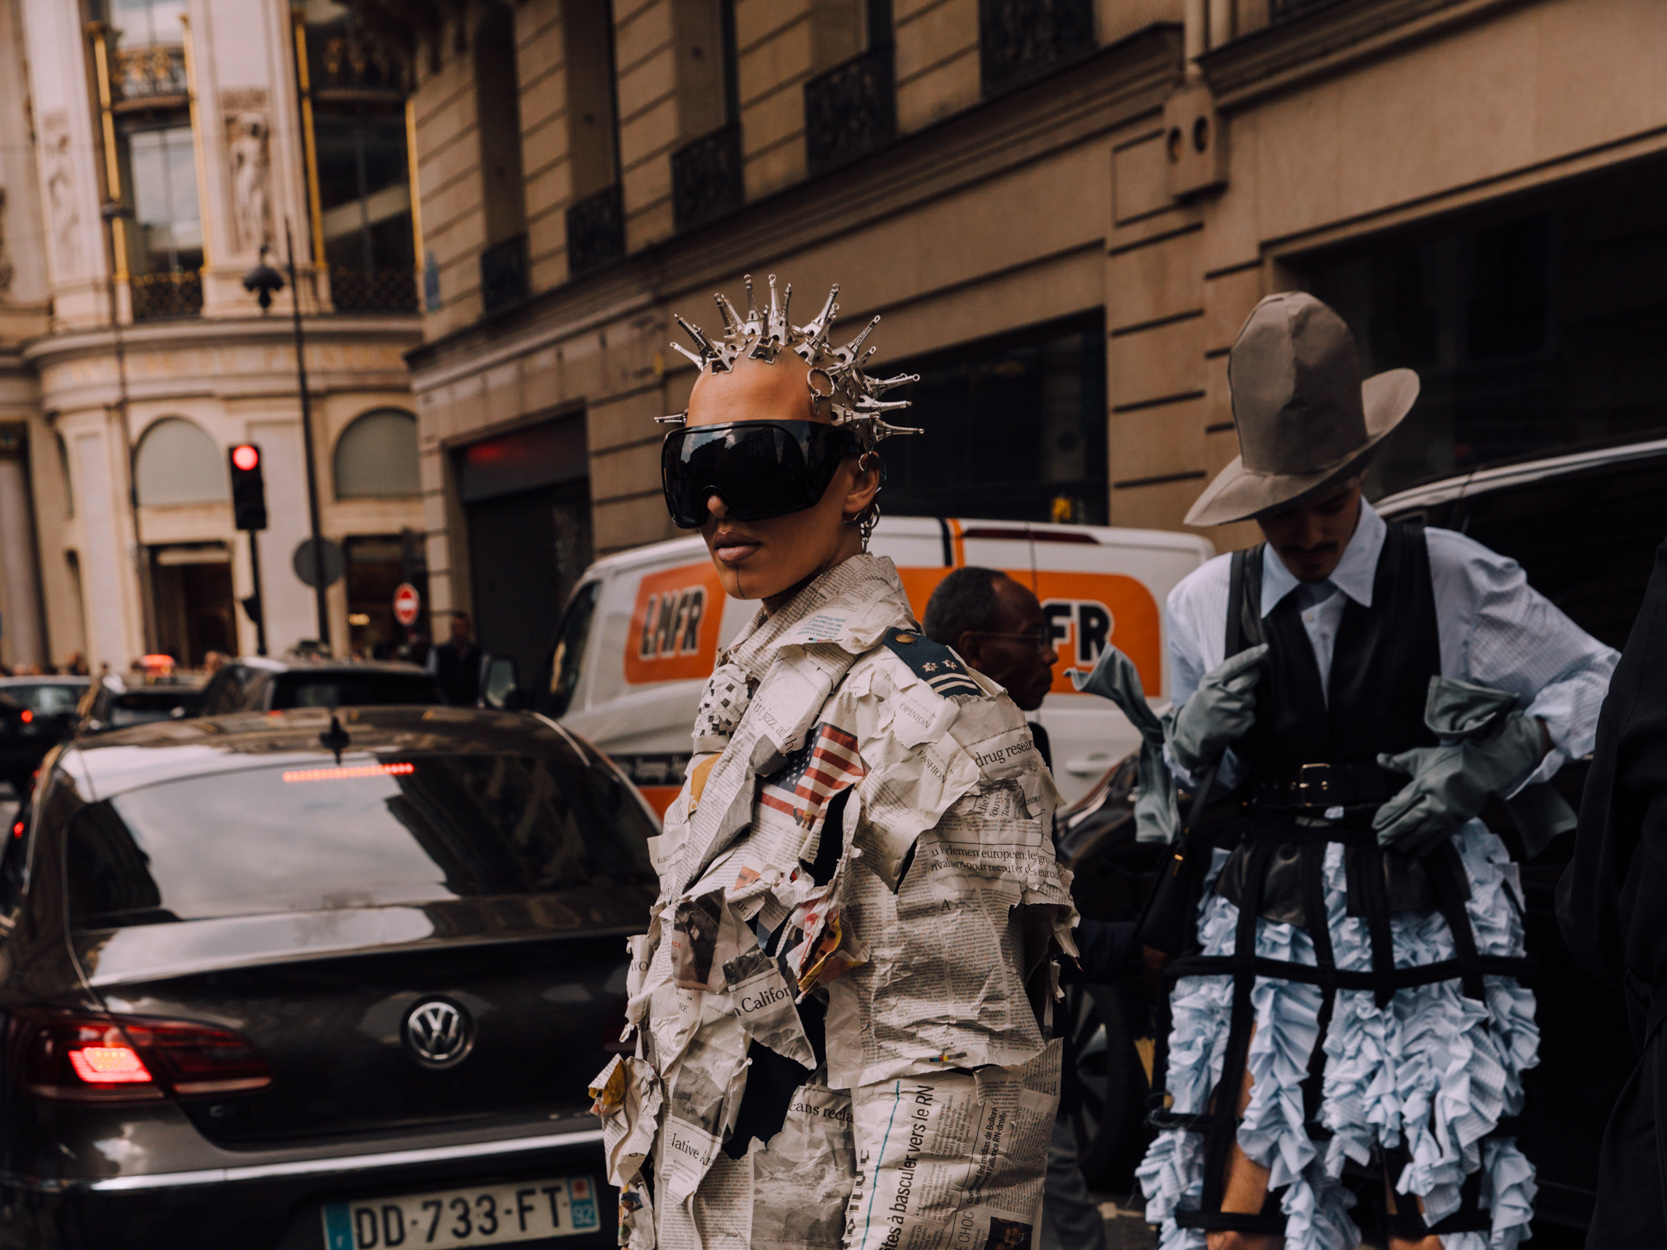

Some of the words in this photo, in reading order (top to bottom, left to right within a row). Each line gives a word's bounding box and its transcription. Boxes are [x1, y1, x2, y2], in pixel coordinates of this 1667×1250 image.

[899, 703, 931, 729] OPINION
[917, 749, 948, 784] FASHION
[975, 748, 1006, 767] drug
[914, 1085, 936, 1107] RN
[911, 1108, 931, 1122] le
[907, 1123, 927, 1152] vers
[976, 1165, 985, 1175] les
[982, 1129, 993, 1141] de
[888, 1154, 919, 1213] basculer
[354, 1185, 563, 1250] DD-733-FT
[886, 1214, 905, 1227] à
[957, 1210, 975, 1244] CHOC
